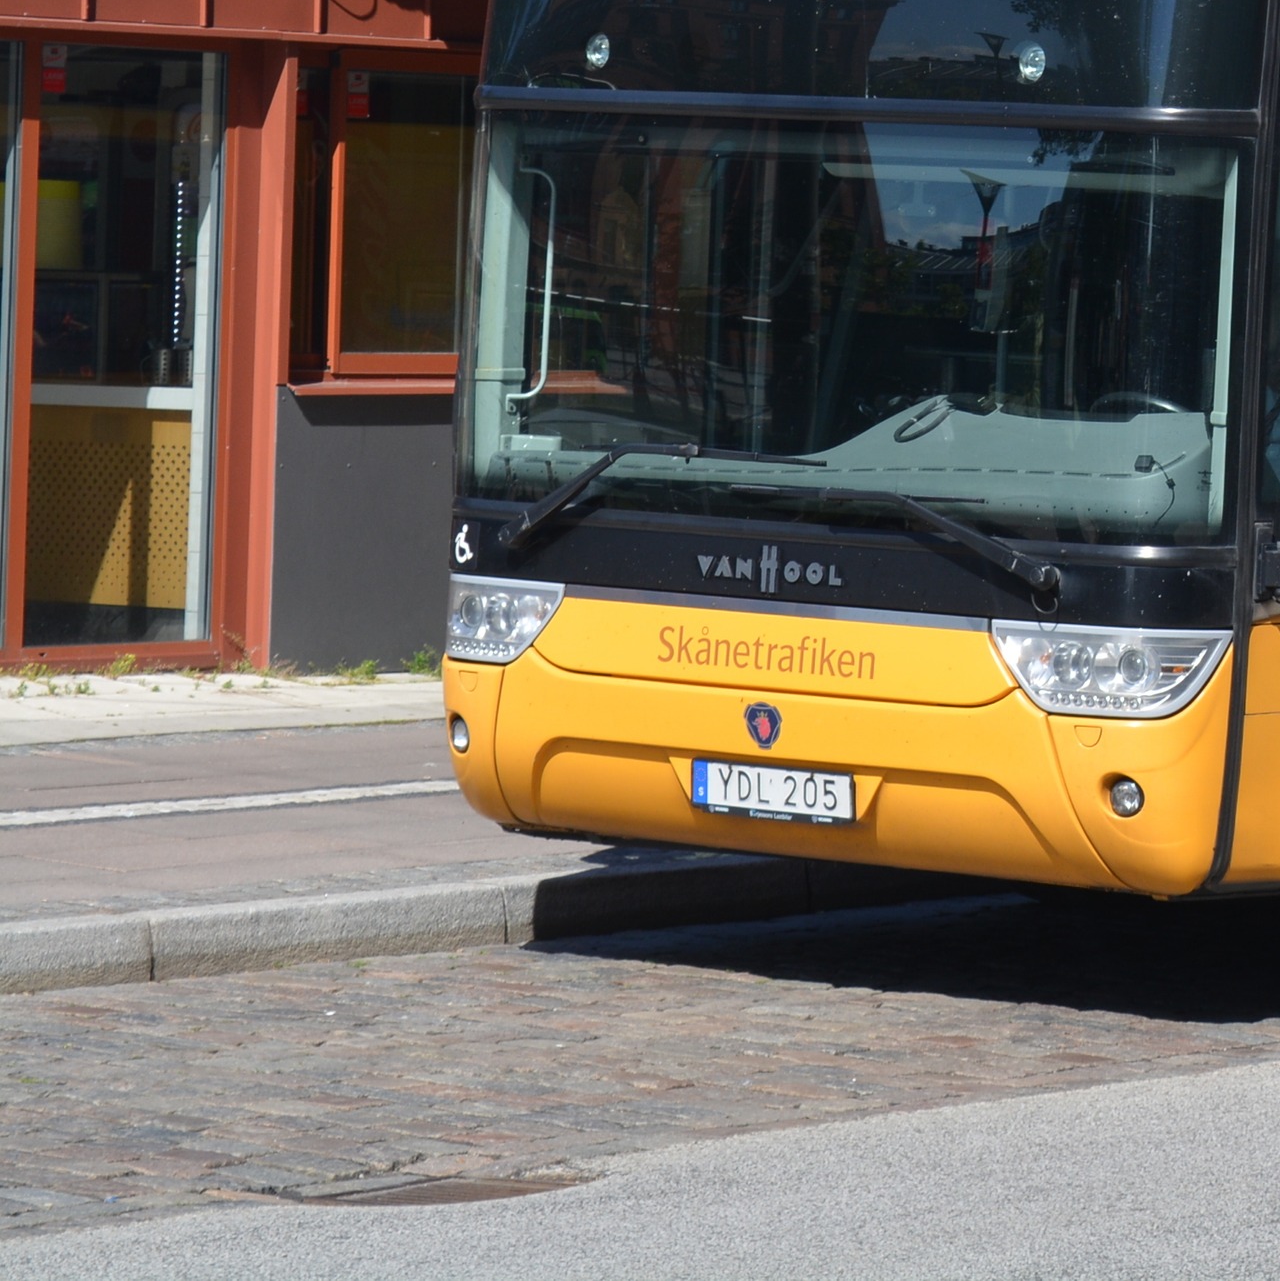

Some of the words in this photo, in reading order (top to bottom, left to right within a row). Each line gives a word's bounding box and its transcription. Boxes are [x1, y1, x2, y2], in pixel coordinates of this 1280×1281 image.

[657, 625, 877, 680] Skånetrafiken
[718, 767, 770, 805] YDL
[783, 775, 838, 811] 205
